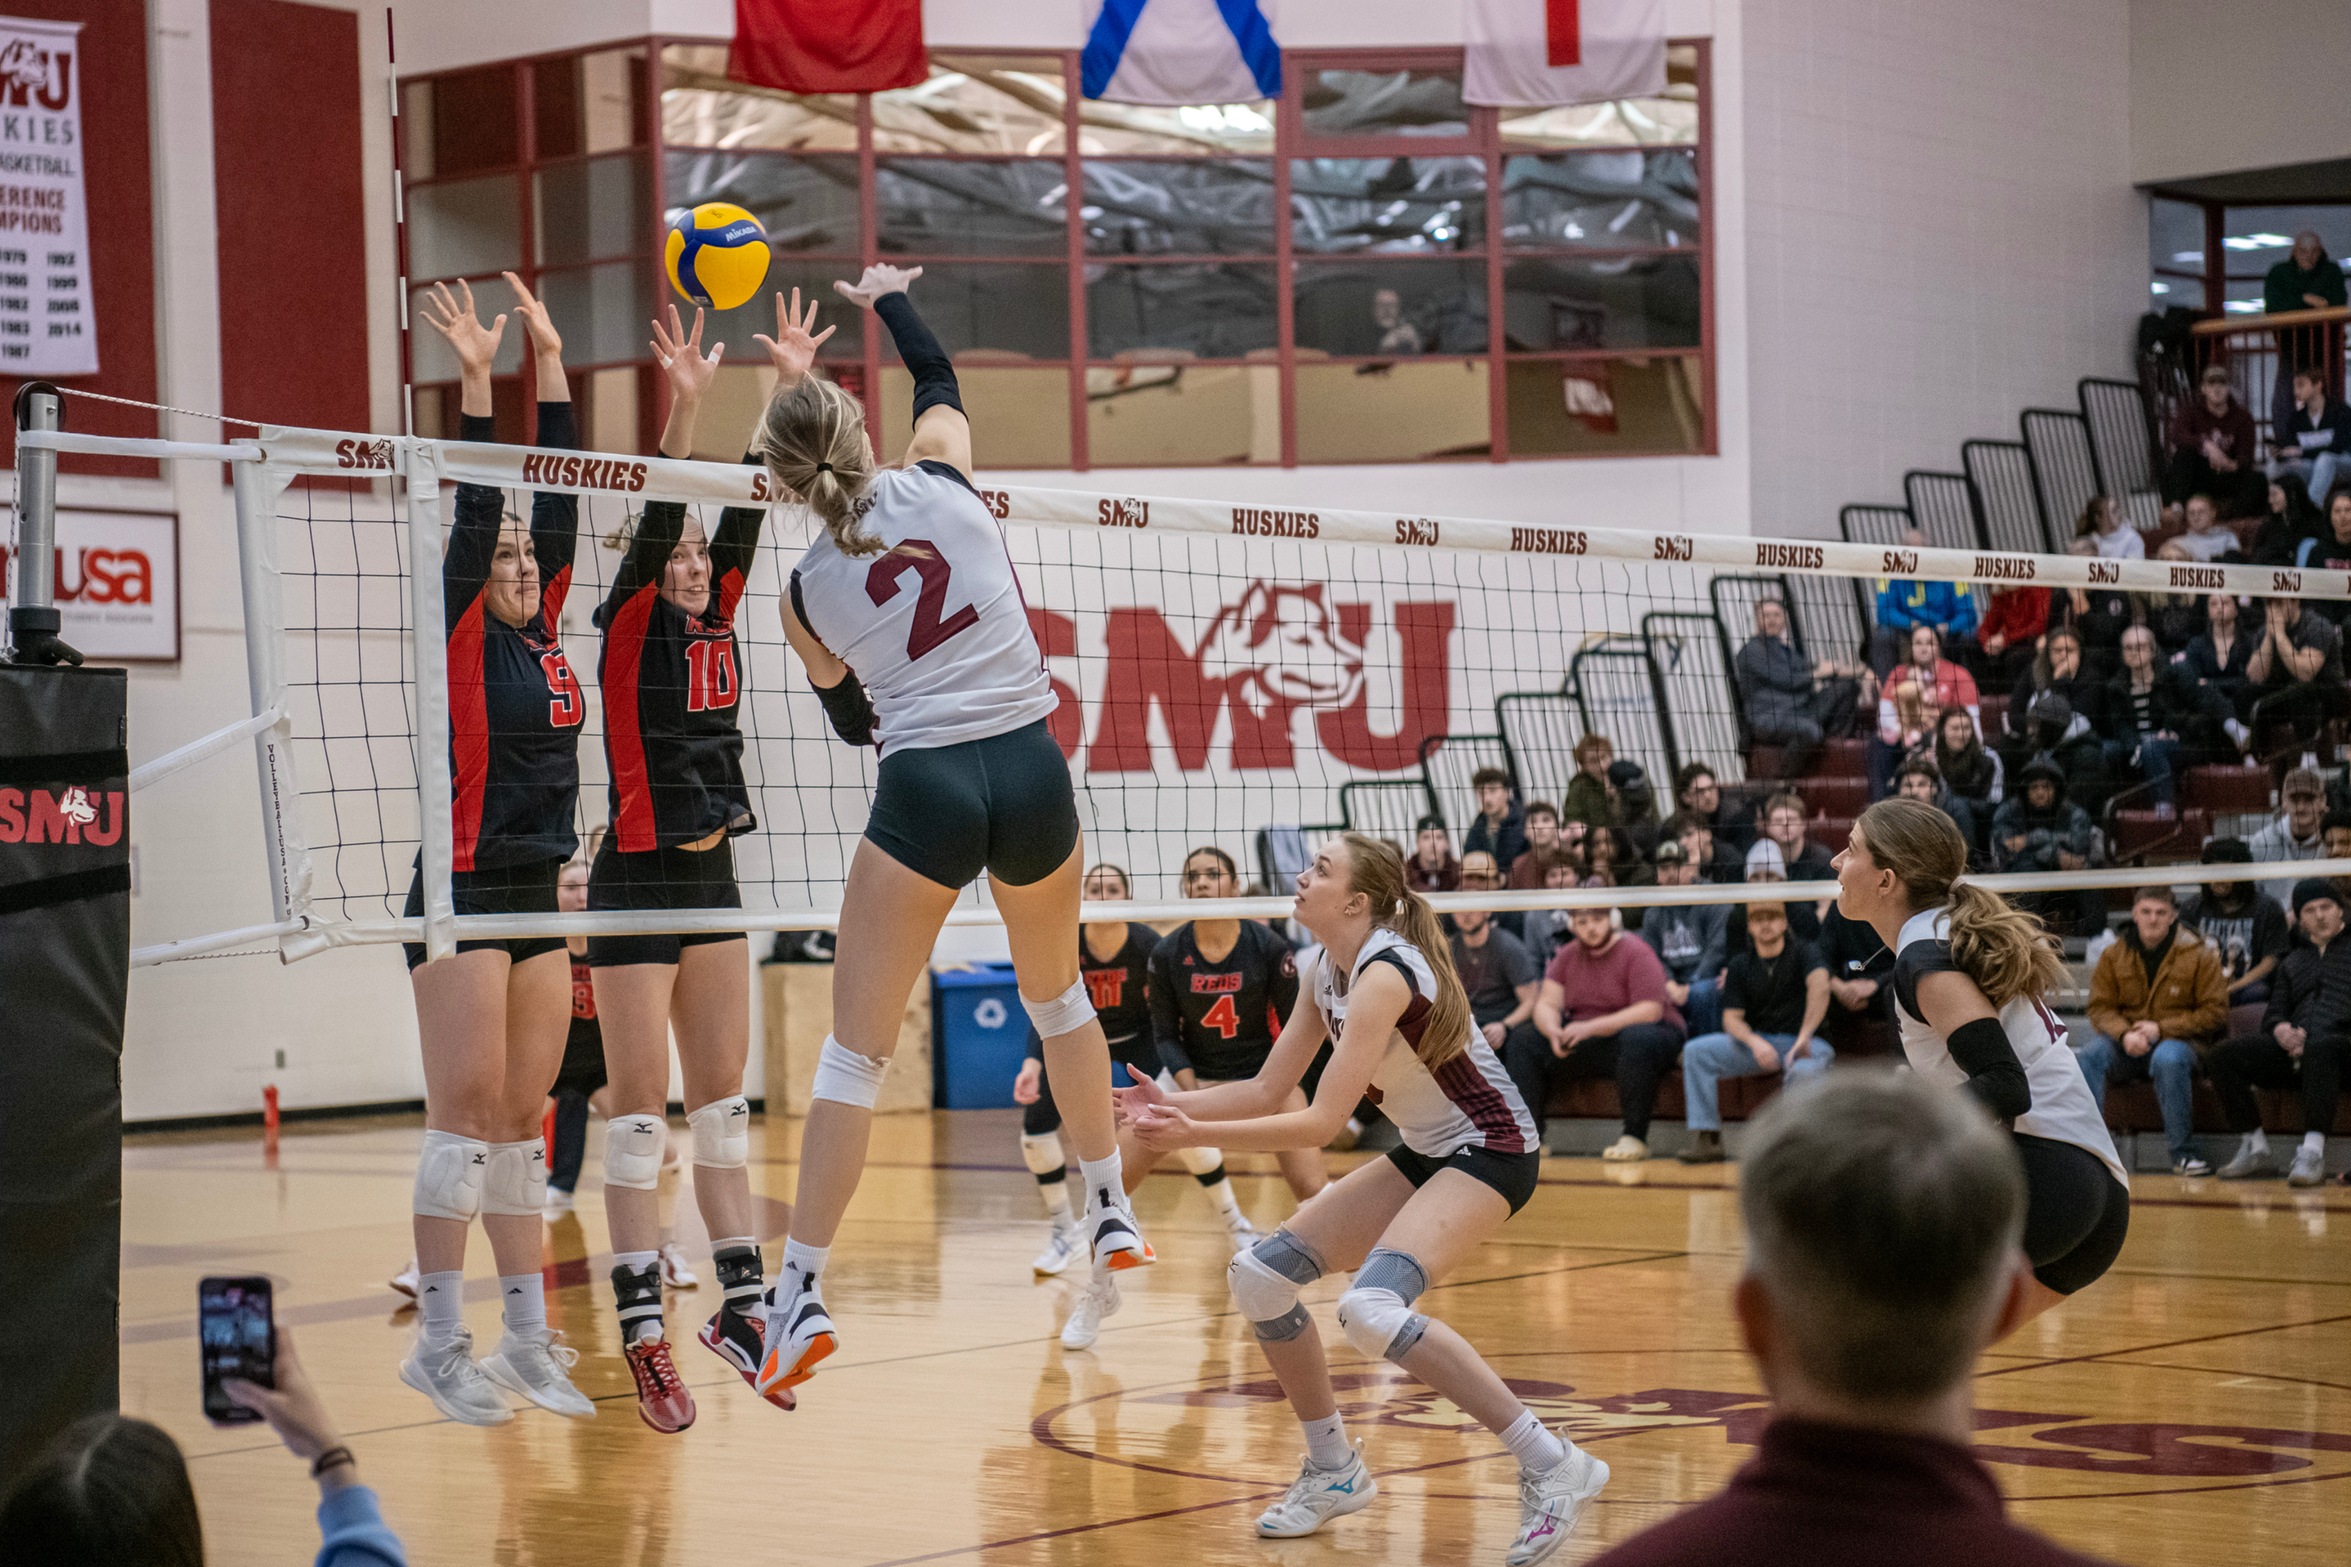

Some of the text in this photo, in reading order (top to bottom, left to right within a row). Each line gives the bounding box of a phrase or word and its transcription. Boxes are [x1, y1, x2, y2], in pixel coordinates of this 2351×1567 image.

[523, 454, 647, 491] HUSKIES
[1099, 498, 1148, 528] SMU
[1232, 508, 1319, 538] HUSKIES
[1395, 519, 1438, 546] SMU
[1511, 527, 1587, 555] HUSKIES
[1654, 536, 1693, 561] SMU
[1756, 544, 1824, 568] HUSKIES
[1883, 552, 1918, 574] SMU
[1974, 557, 2035, 580] HUSKIES
[2088, 562, 2120, 584] SMU
[2170, 566, 2225, 588] HUSKIES
[2273, 572, 2301, 592] SMU
[865, 538, 981, 662] 2
[540, 653, 583, 727] 9
[684, 636, 738, 712] 10
[0, 787, 124, 847] SMU
[1200, 994, 1240, 1039] 4
